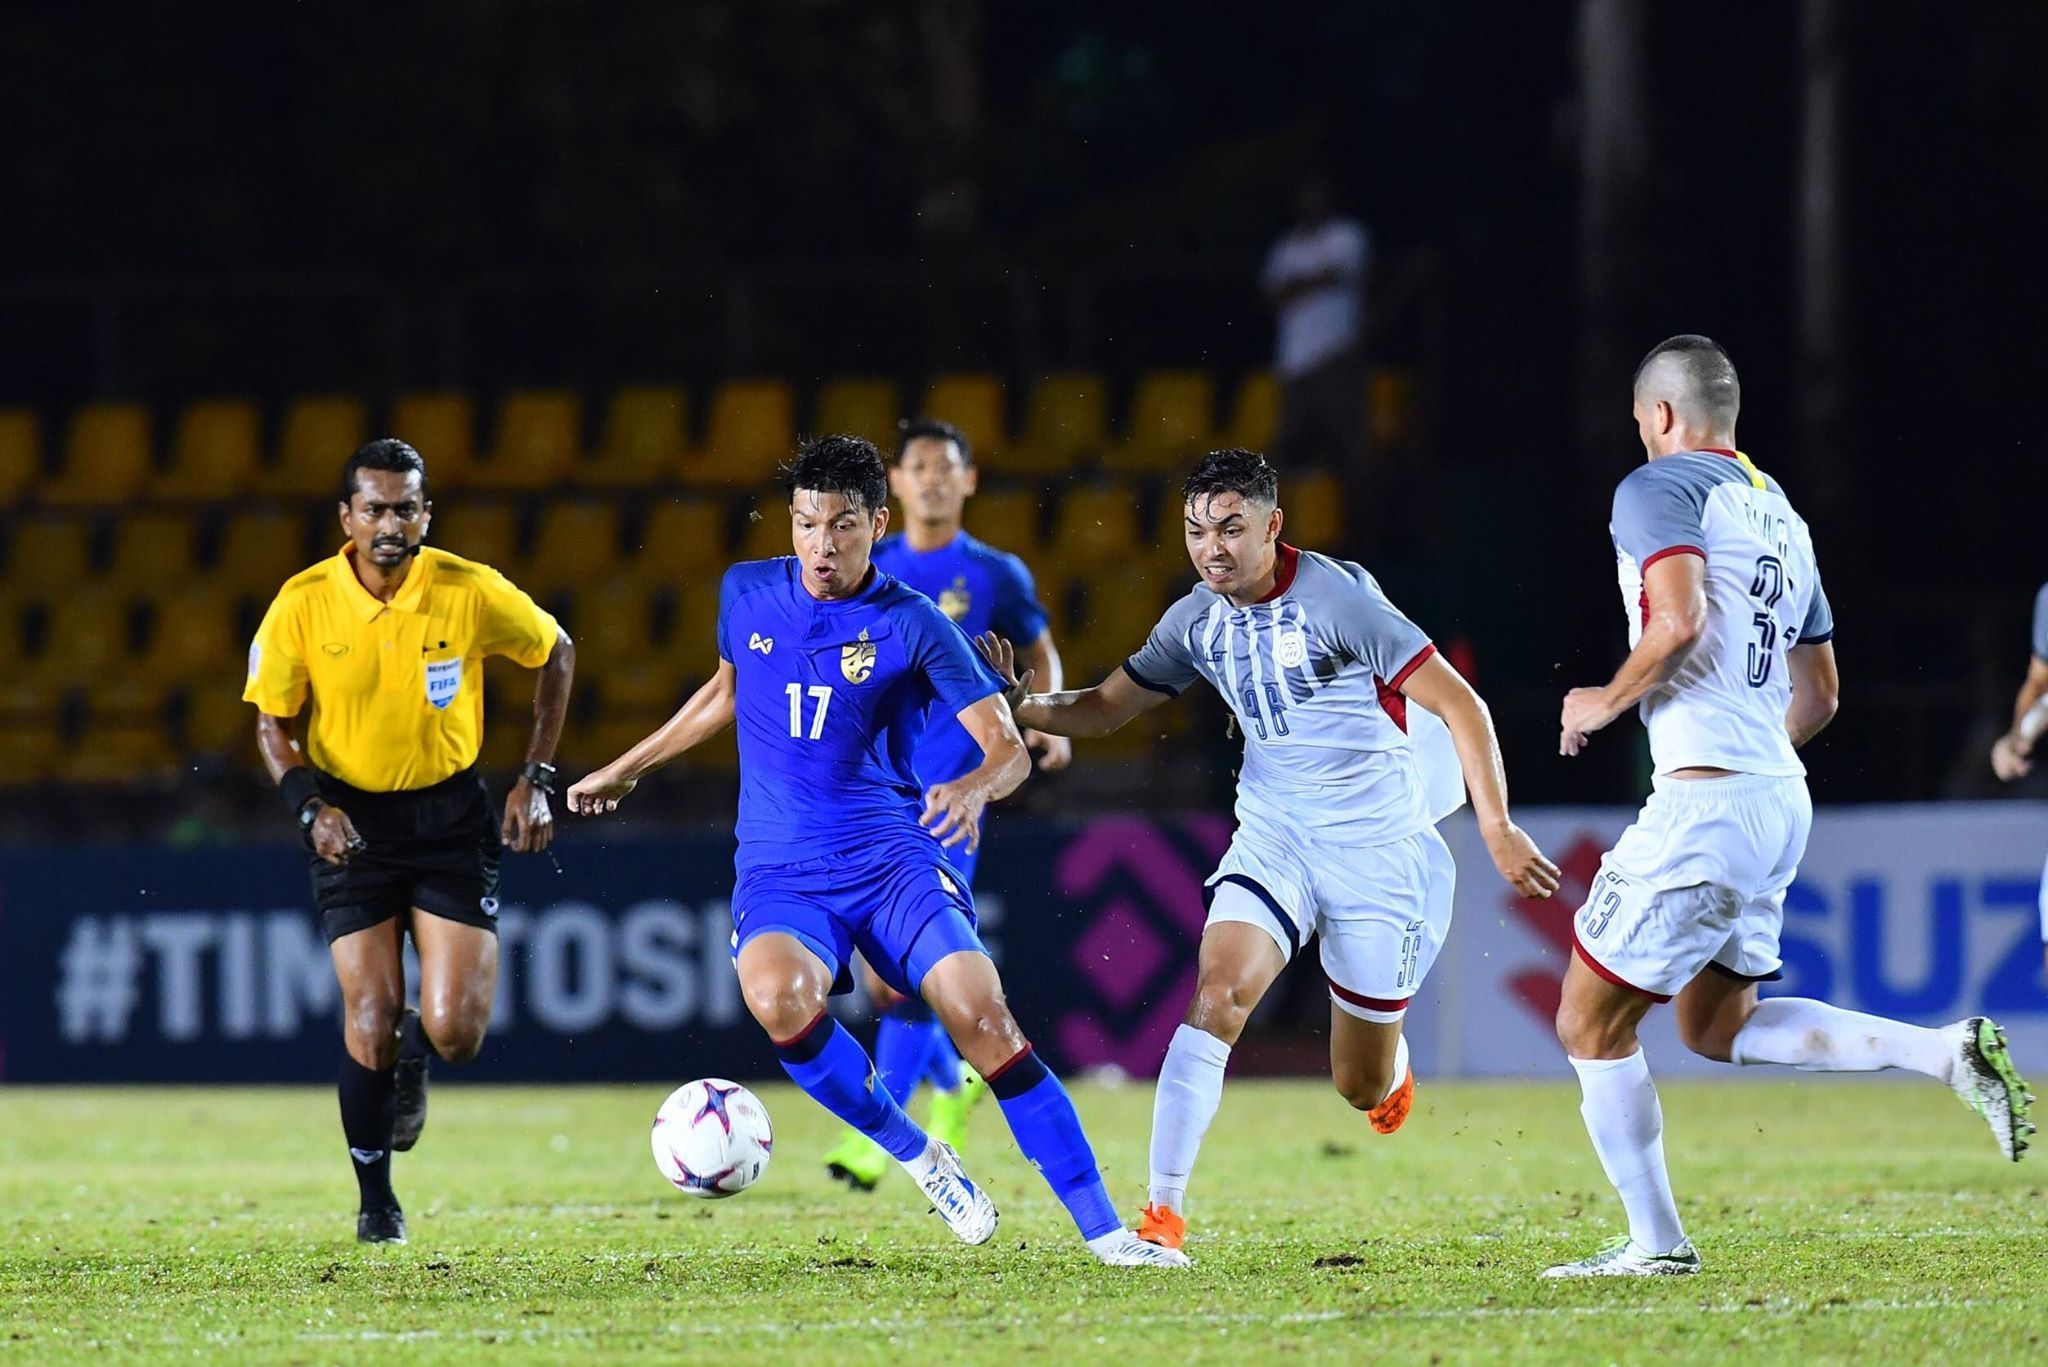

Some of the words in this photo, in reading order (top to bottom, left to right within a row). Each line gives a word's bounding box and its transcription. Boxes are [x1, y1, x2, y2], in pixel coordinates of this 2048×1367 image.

[430, 677, 457, 691] FIFA
[784, 682, 833, 740] 17
[1244, 686, 1290, 740] 36
[1397, 935, 1422, 988] 36
